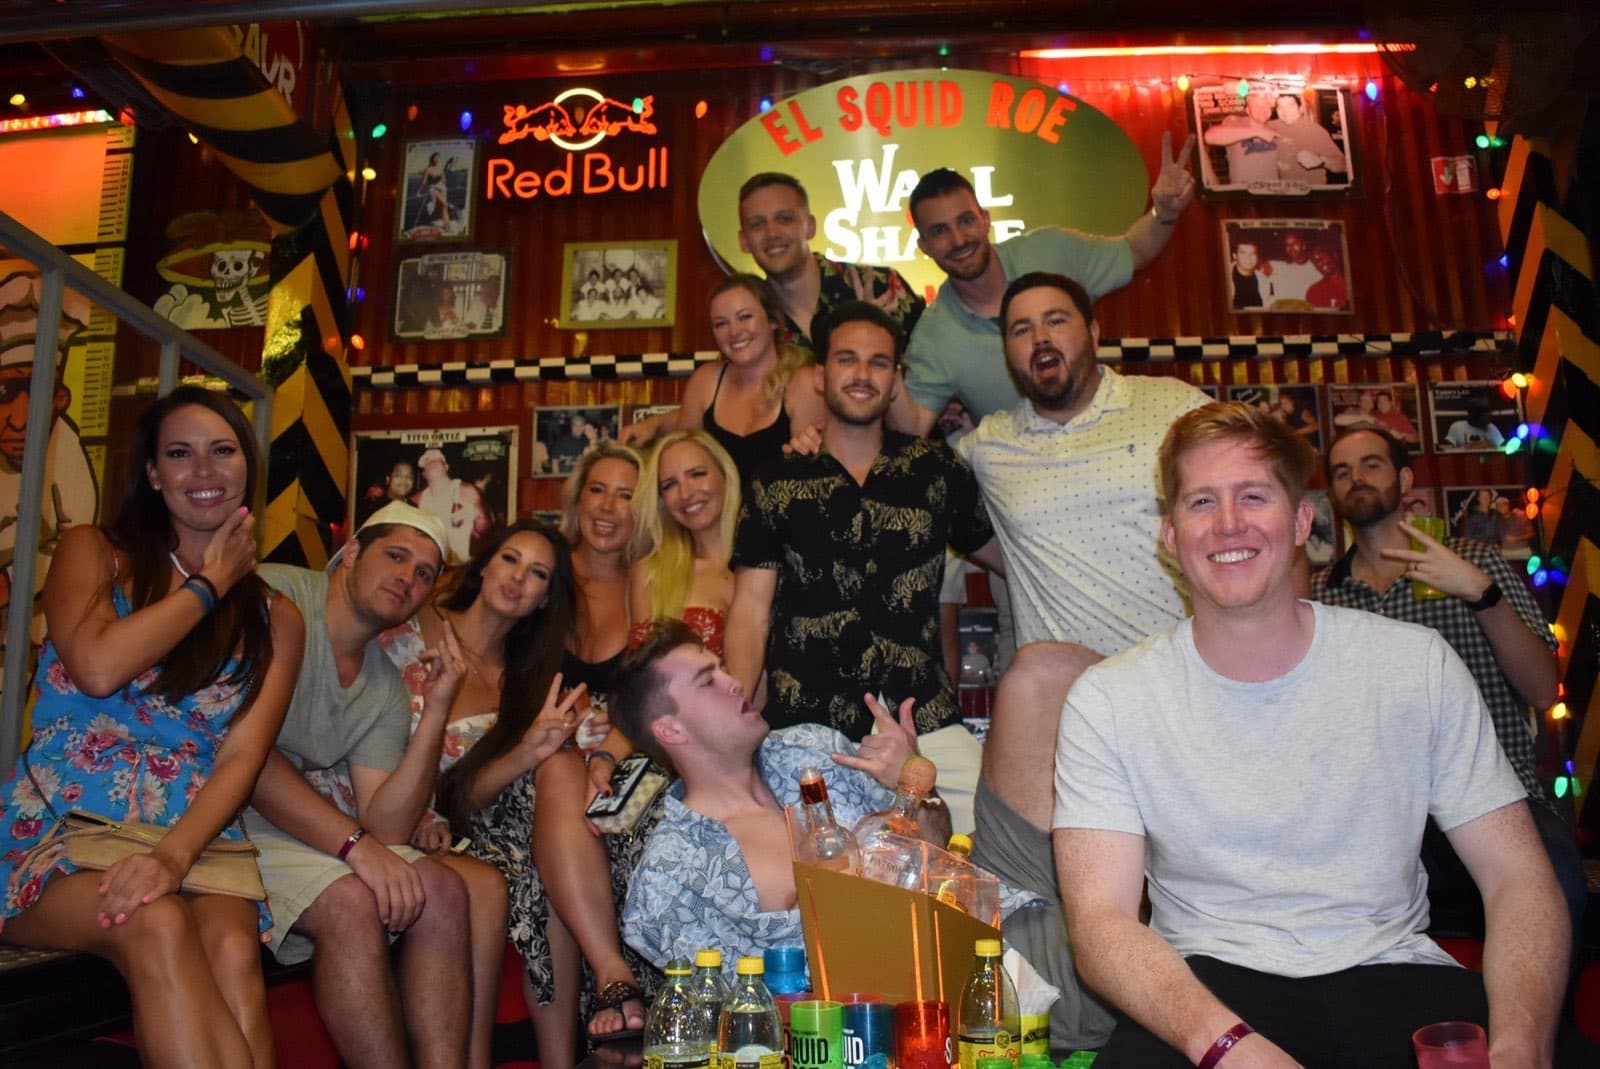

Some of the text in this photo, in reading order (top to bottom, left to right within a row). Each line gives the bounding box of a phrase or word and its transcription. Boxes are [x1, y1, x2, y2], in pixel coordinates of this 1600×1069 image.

[759, 80, 1078, 157] EL SQUID ROE
[487, 147, 668, 200] Red Bull
[832, 144, 1013, 213] WAL
[823, 207, 1026, 264] SHE
